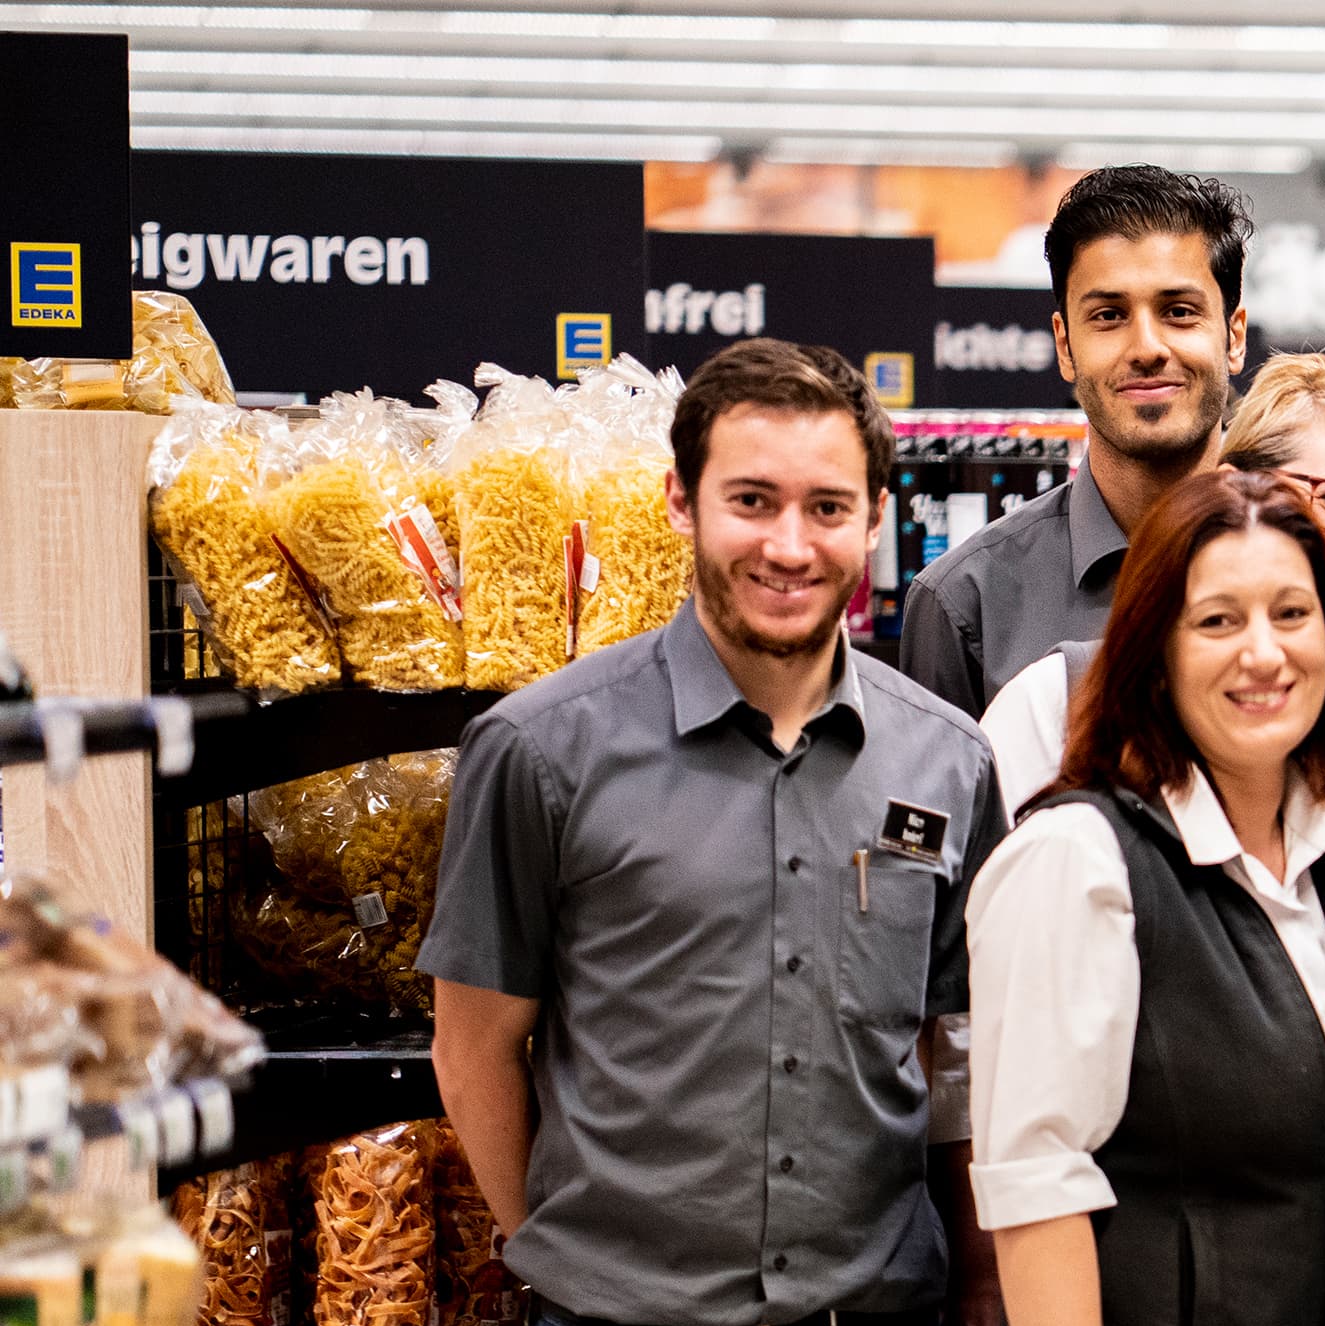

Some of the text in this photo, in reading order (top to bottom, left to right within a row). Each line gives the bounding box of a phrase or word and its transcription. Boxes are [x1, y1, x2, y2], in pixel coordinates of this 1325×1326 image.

[19, 250, 74, 305] E
[132, 221, 430, 290] igwaren
[19, 308, 75, 319] EDEKA
